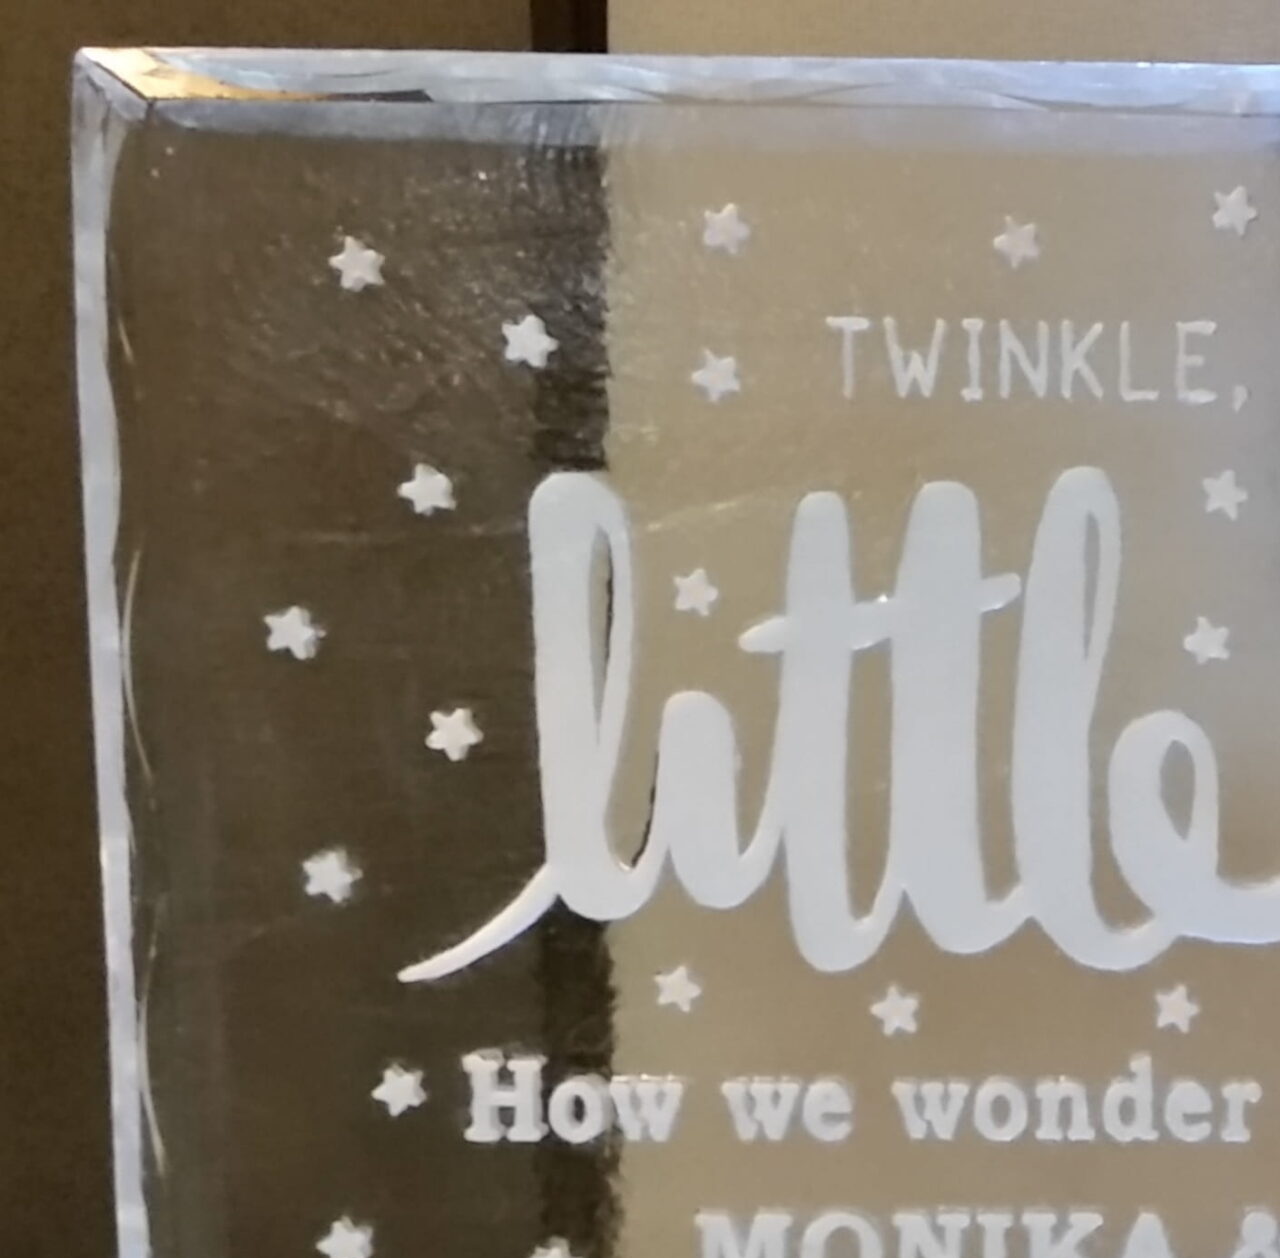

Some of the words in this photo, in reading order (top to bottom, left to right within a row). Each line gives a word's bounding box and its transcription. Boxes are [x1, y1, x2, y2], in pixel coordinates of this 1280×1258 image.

[830, 317, 1250, 411] TWINKLE,
[462, 1051, 689, 1143] How
[724, 1077, 855, 1141] we
[894, 1054, 1260, 1142] wonder
